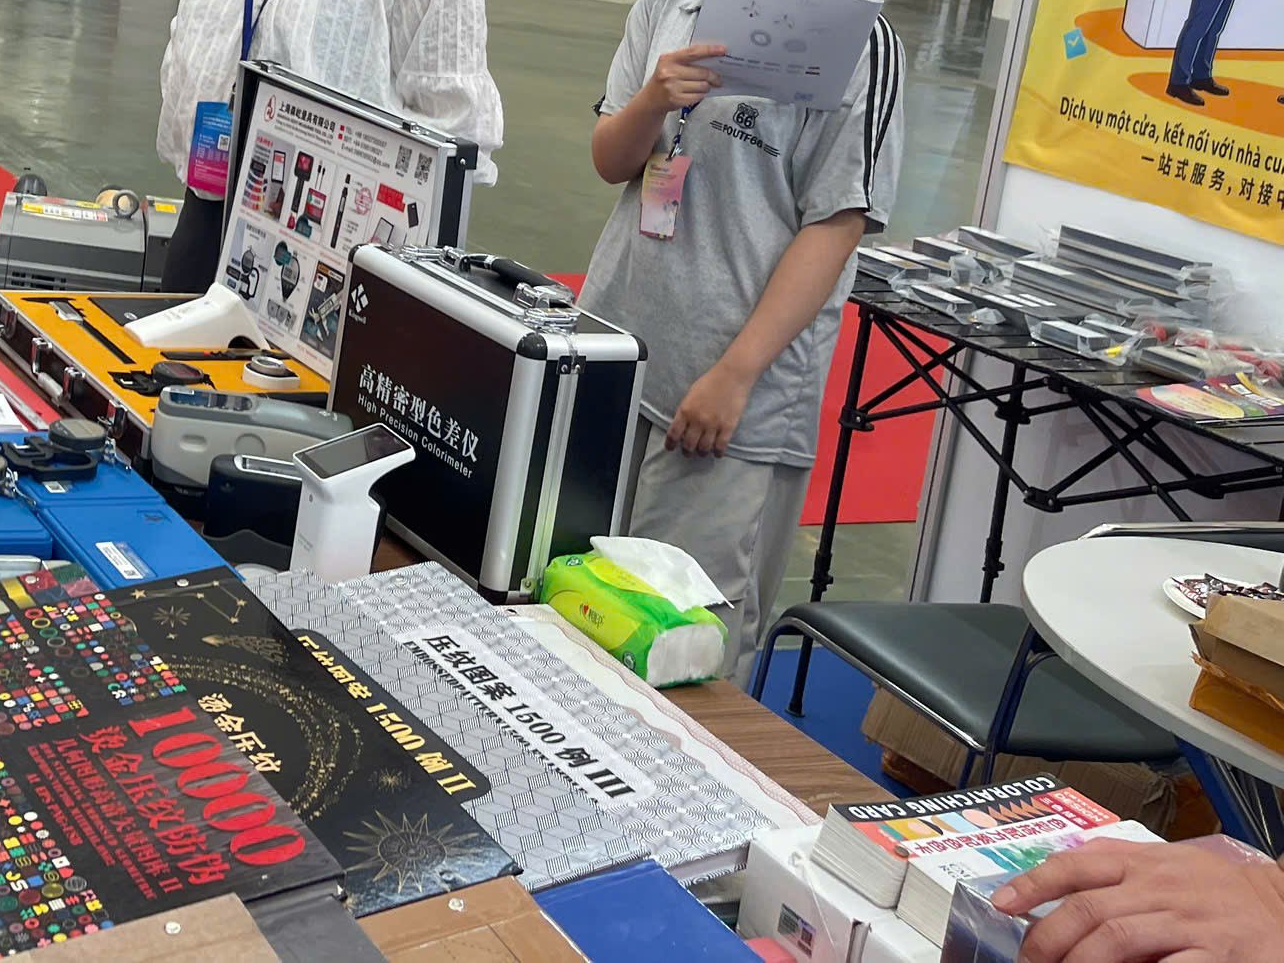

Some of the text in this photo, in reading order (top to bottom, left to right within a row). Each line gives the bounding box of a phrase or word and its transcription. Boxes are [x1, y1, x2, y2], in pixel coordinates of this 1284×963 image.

[736, 111, 753, 128] 66
[1060, 96, 1086, 121] Dịch
[1088, 107, 1104, 126] vụ
[1105, 111, 1131, 135] một
[1132, 114, 1160, 144] cửa,
[1163, 121, 1184, 147] kết
[1186, 128, 1210, 153] nối
[1211, 137, 1235, 158] với
[1236, 142, 1261, 168] nhà
[357, 393, 473, 479] High Precision Colorimeter
[359, 363, 479, 463] 高精密型色差仪
[422, 635, 636, 799] 压纹图案 1500 例 III
[128, 706, 305, 866] 10000
[848, 776, 1056, 819] COLORATCHING CARD
[1053, 792, 1102, 822] DESIGN
